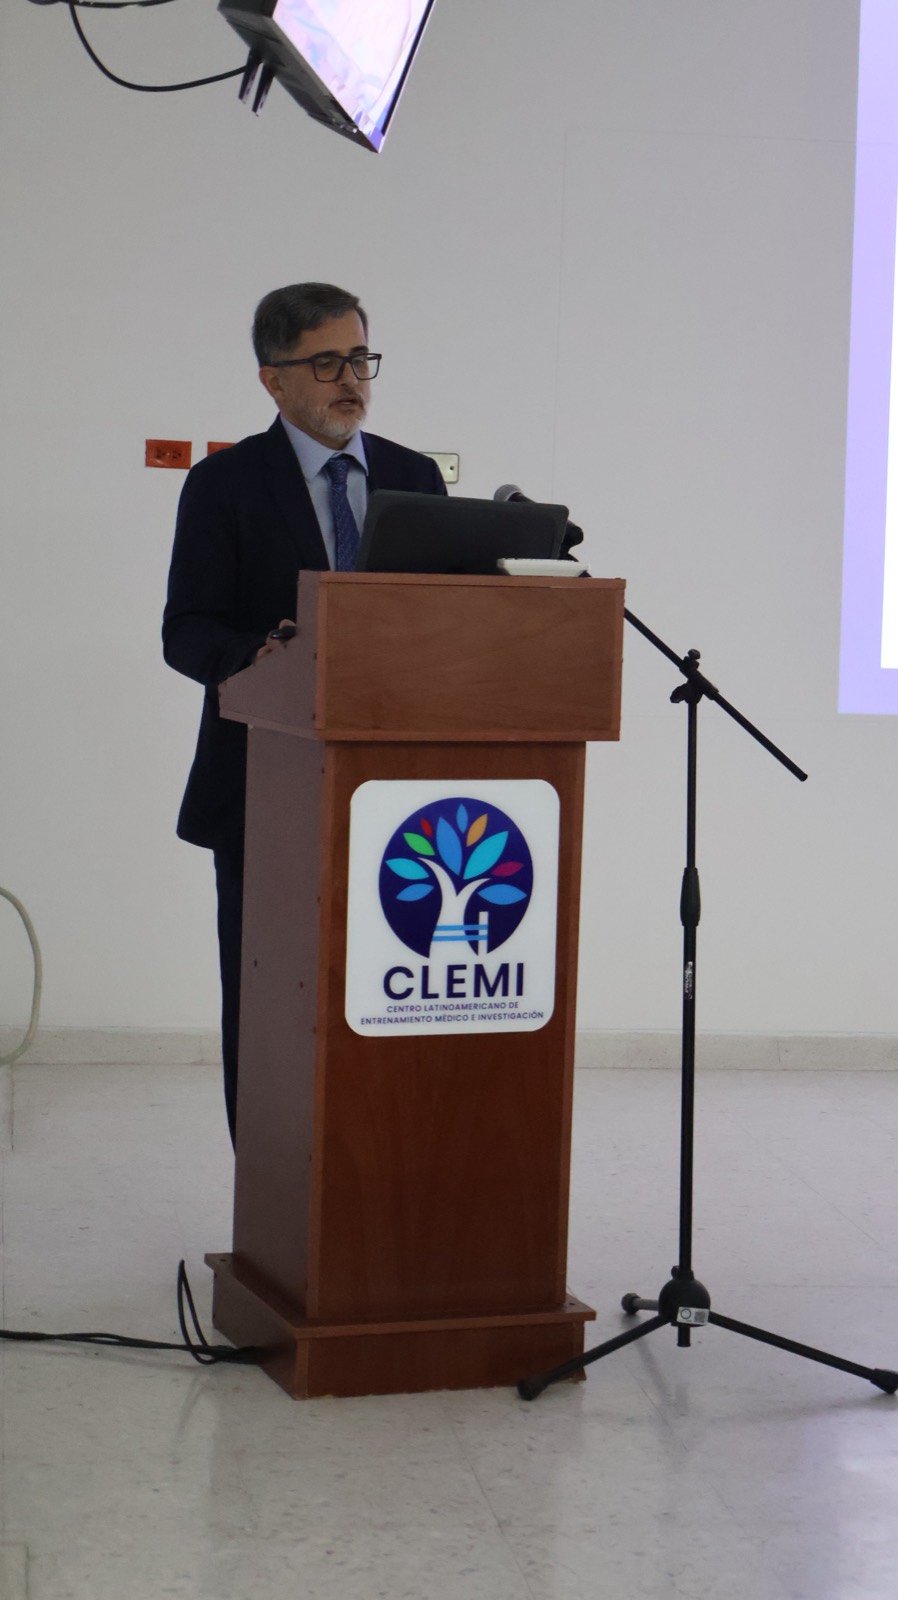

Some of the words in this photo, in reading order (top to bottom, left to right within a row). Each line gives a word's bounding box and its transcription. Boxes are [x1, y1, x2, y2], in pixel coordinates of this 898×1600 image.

[383, 962, 524, 1000] CLEMI
[386, 1004, 422, 1013] CENTRO
[423, 1002, 506, 1012] LATINOAMERICANO
[508, 1001, 519, 1009] DE
[360, 1015, 433, 1025] ENTRENAMIENTO
[434, 1013, 469, 1023] MÉDICO
[477, 1011, 544, 1021] INVESTIGACIÓN
